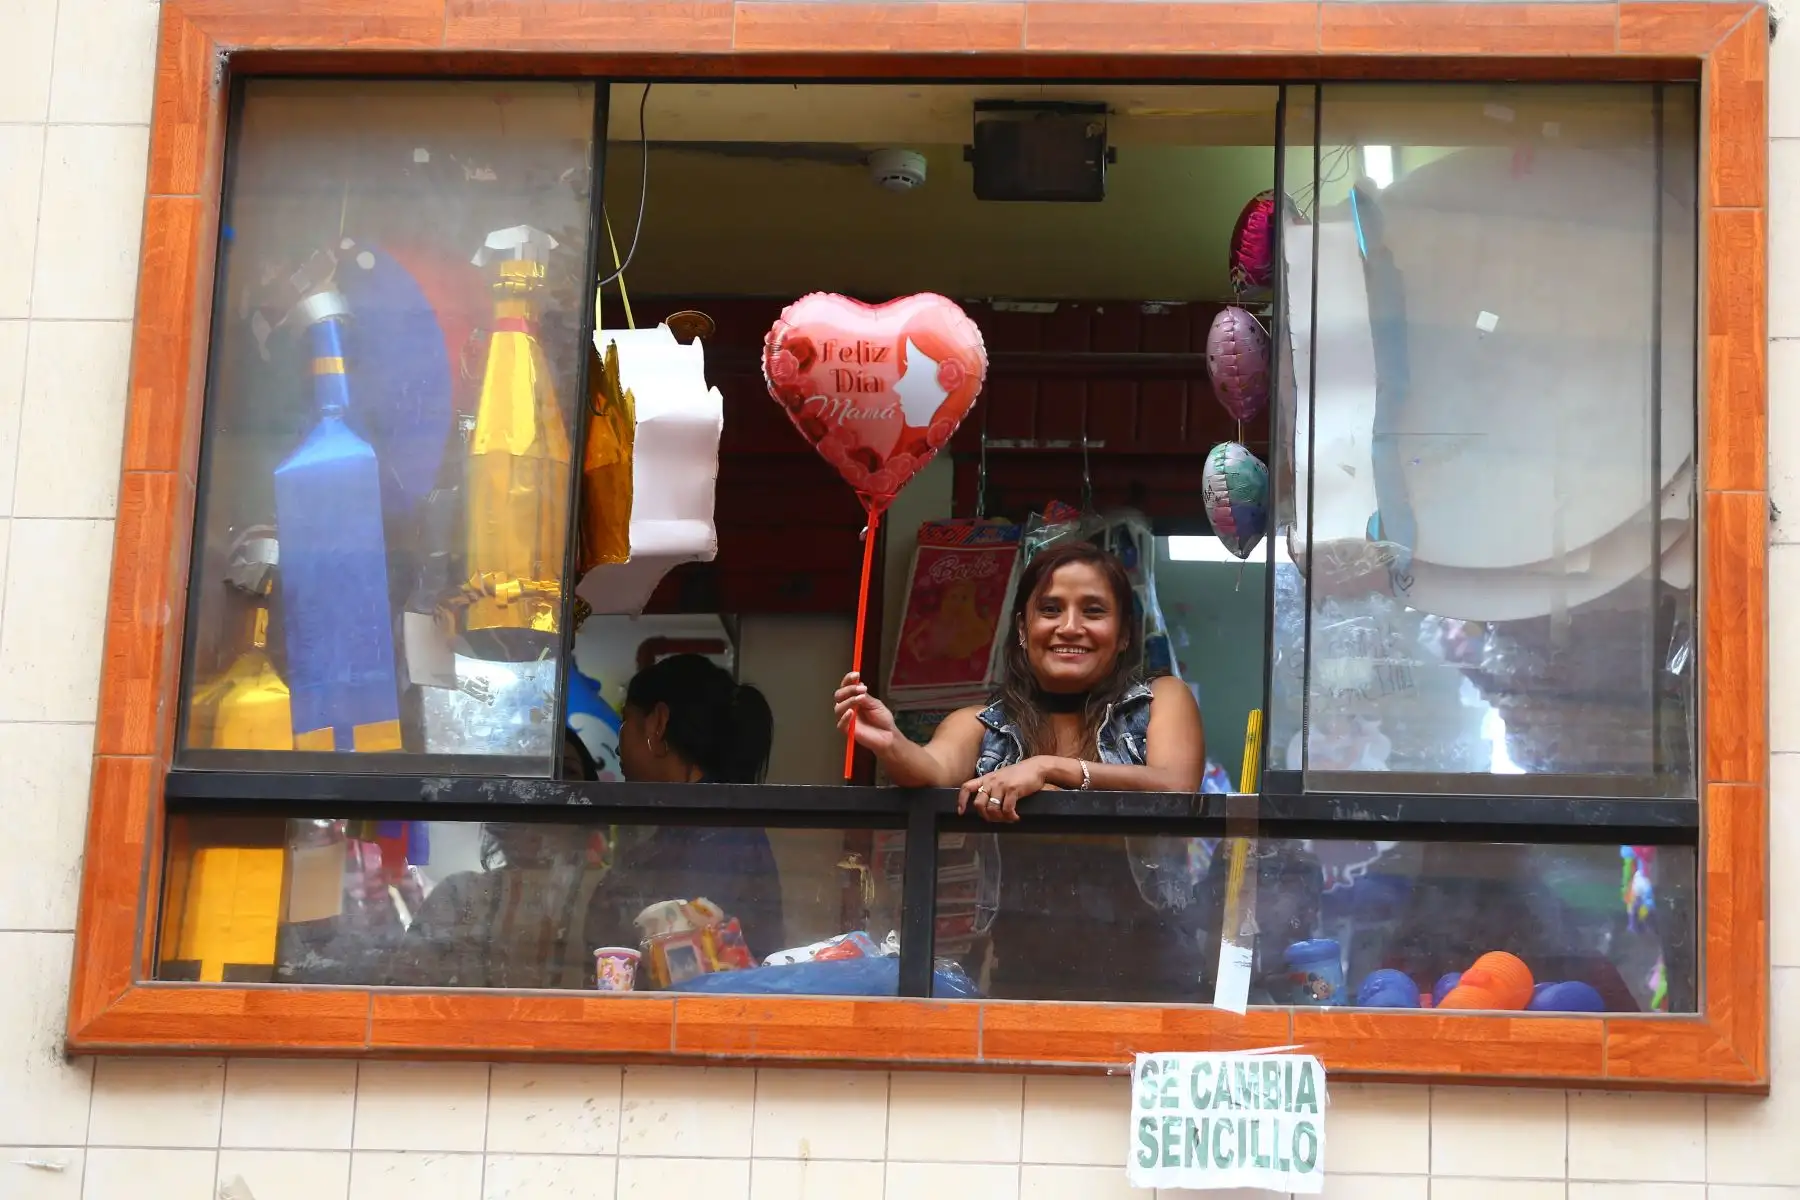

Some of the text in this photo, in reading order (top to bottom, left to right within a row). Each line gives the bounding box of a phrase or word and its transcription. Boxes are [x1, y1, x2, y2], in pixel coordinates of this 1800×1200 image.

[817, 338, 891, 366] Feliz
[804, 394, 898, 426] Mamá
[1139, 1059, 1319, 1114] SE CAMBIA
[1137, 1115, 1318, 1174] SENCILLO
